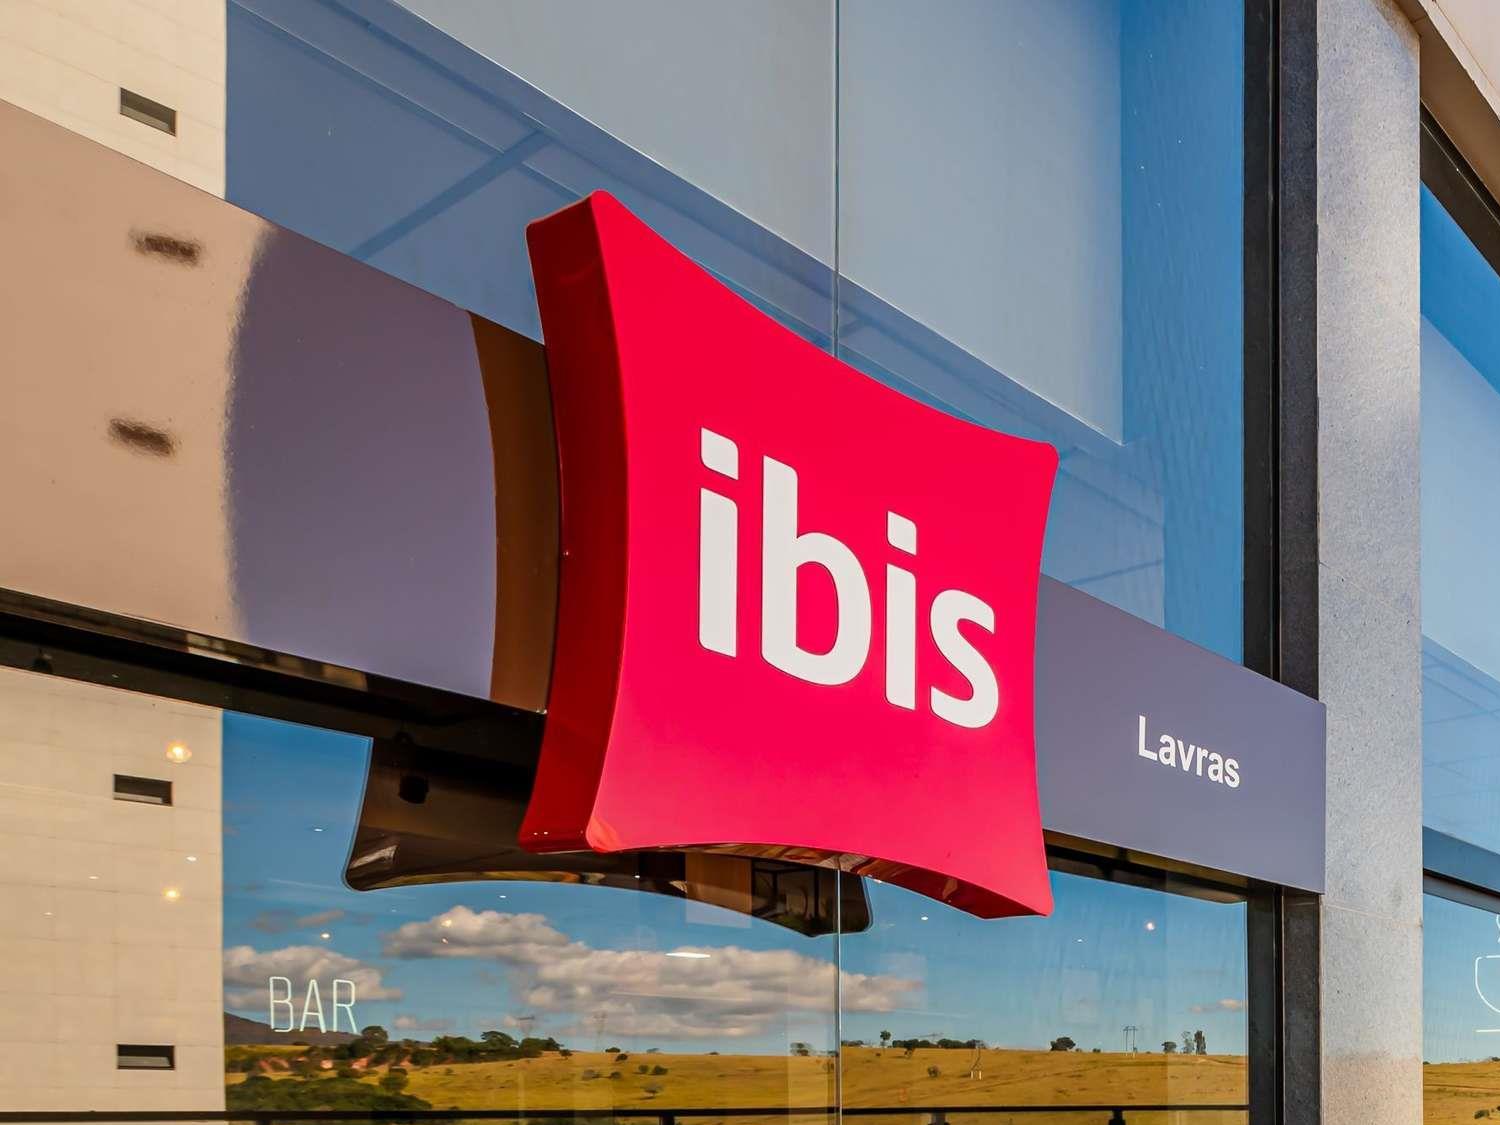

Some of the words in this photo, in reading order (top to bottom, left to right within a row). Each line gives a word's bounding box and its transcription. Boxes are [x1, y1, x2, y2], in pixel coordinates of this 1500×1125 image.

[699, 427, 999, 729] ibis
[1138, 714, 1241, 789] Lavras
[269, 976, 359, 1034] BAR
